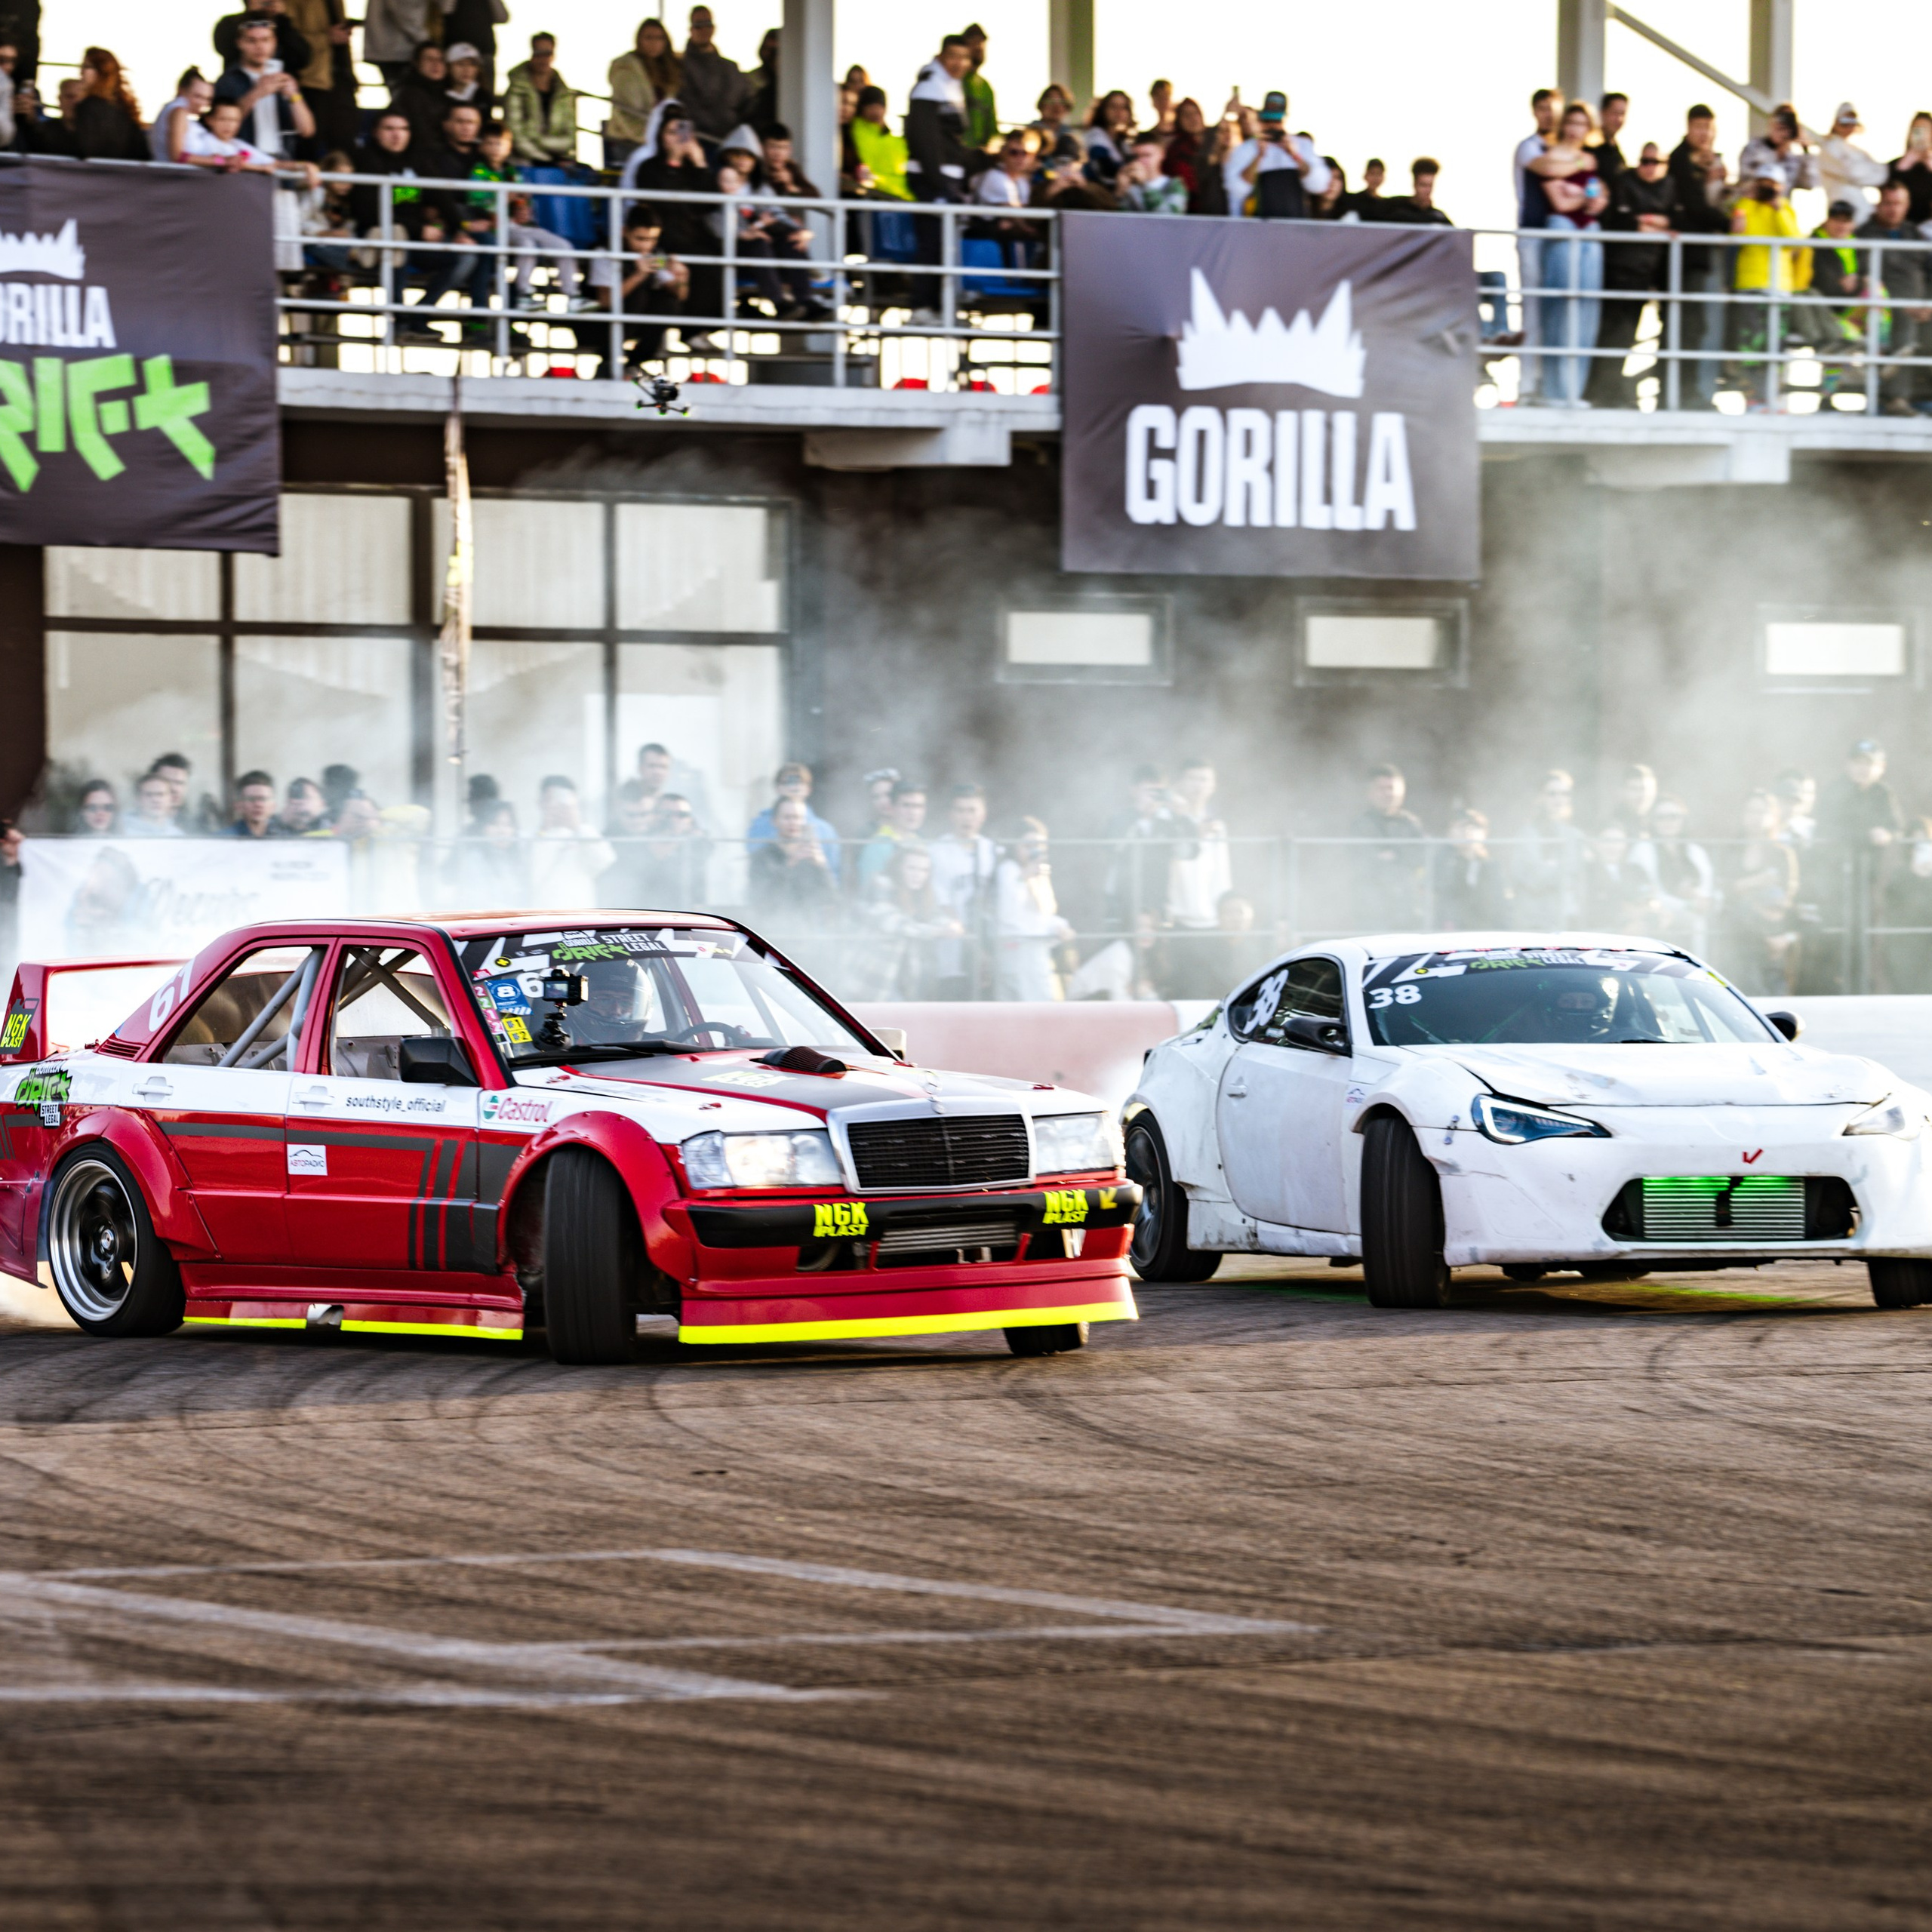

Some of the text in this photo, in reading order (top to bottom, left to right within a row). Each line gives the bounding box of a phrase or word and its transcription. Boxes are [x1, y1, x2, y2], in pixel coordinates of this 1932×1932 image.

[0, 282, 117, 348] RILLA
[1125, 405, 1417, 530] GORILLA
[600, 933, 651, 944] STREET
[624, 942, 667, 952] LEGAL
[474, 986, 486, 996] 2
[497, 986, 515, 998] 8
[1367, 984, 1422, 1009] 38
[479, 998, 491, 1008] 2
[1243, 969, 1289, 1035] 38
[5, 1014, 32, 1037] NGK
[0, 1036, 24, 1048] PLAST
[42, 1104, 57, 1115] STREET
[346, 1094, 447, 1113] southstyle_official
[498, 1097, 553, 1122] Castrol
[45, 1115, 59, 1124] LEGAL
[1043, 1189, 1089, 1213] NGK
[814, 1201, 869, 1226] NGK
[1041, 1209, 1089, 1225] PLAST
[813, 1223, 869, 1238] PLAST
